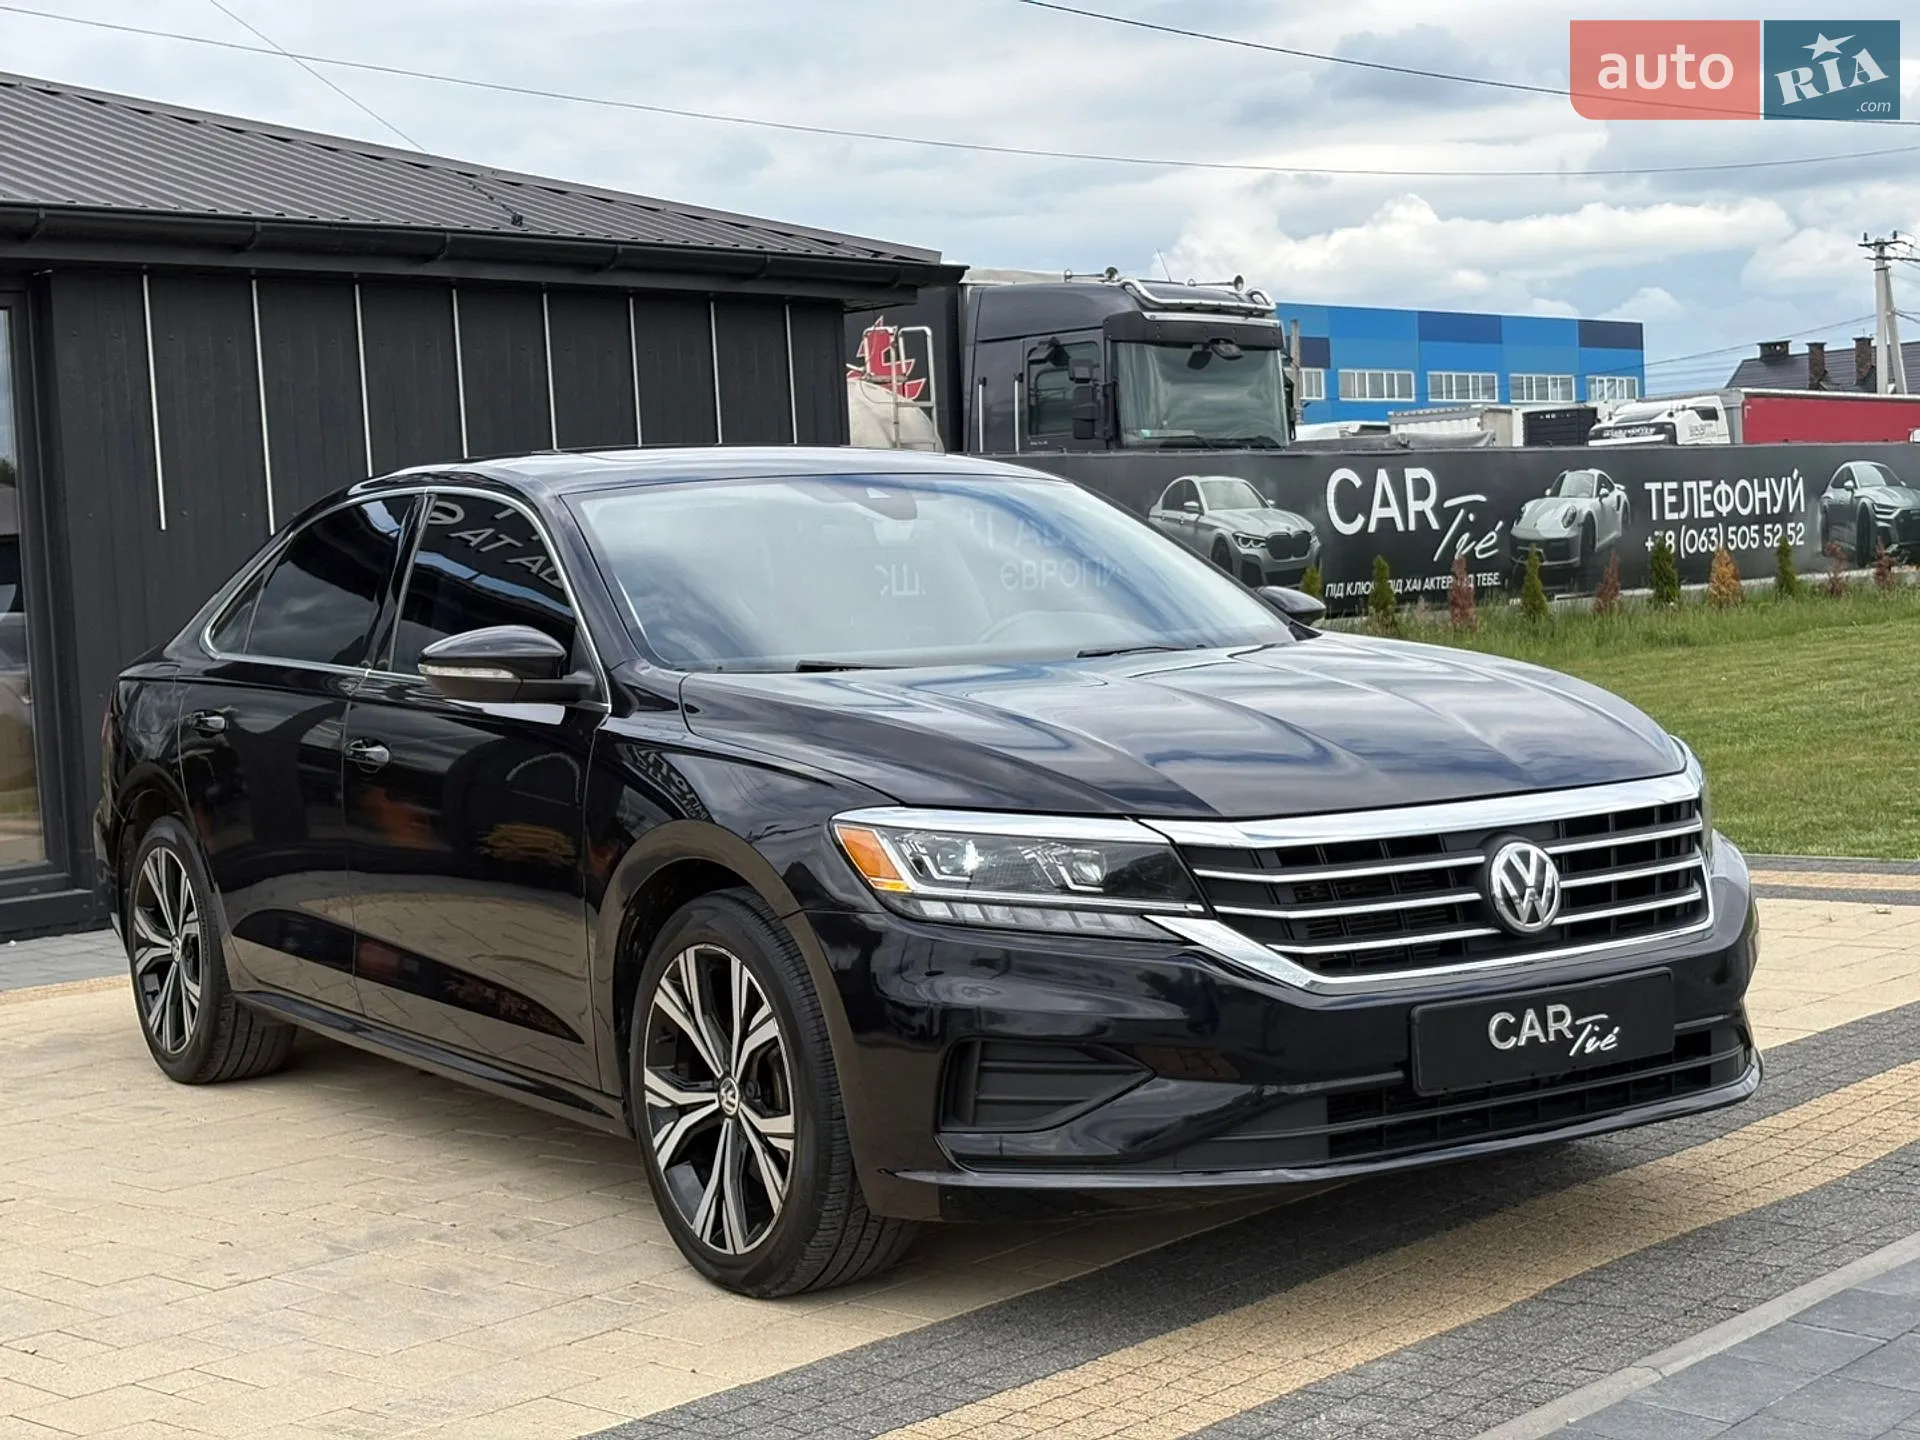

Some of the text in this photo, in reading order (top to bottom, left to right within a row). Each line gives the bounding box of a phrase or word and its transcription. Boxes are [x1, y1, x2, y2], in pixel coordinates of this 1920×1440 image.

[1326, 467, 1440, 535] CAR
[1644, 468, 1806, 521] ТЕЛЕФОНУЙ
[1644, 522, 1806, 559] +8 (063) 505 52 52
[1325, 582, 1345, 599] ПІД
[1488, 1003, 1574, 1050] CAR
